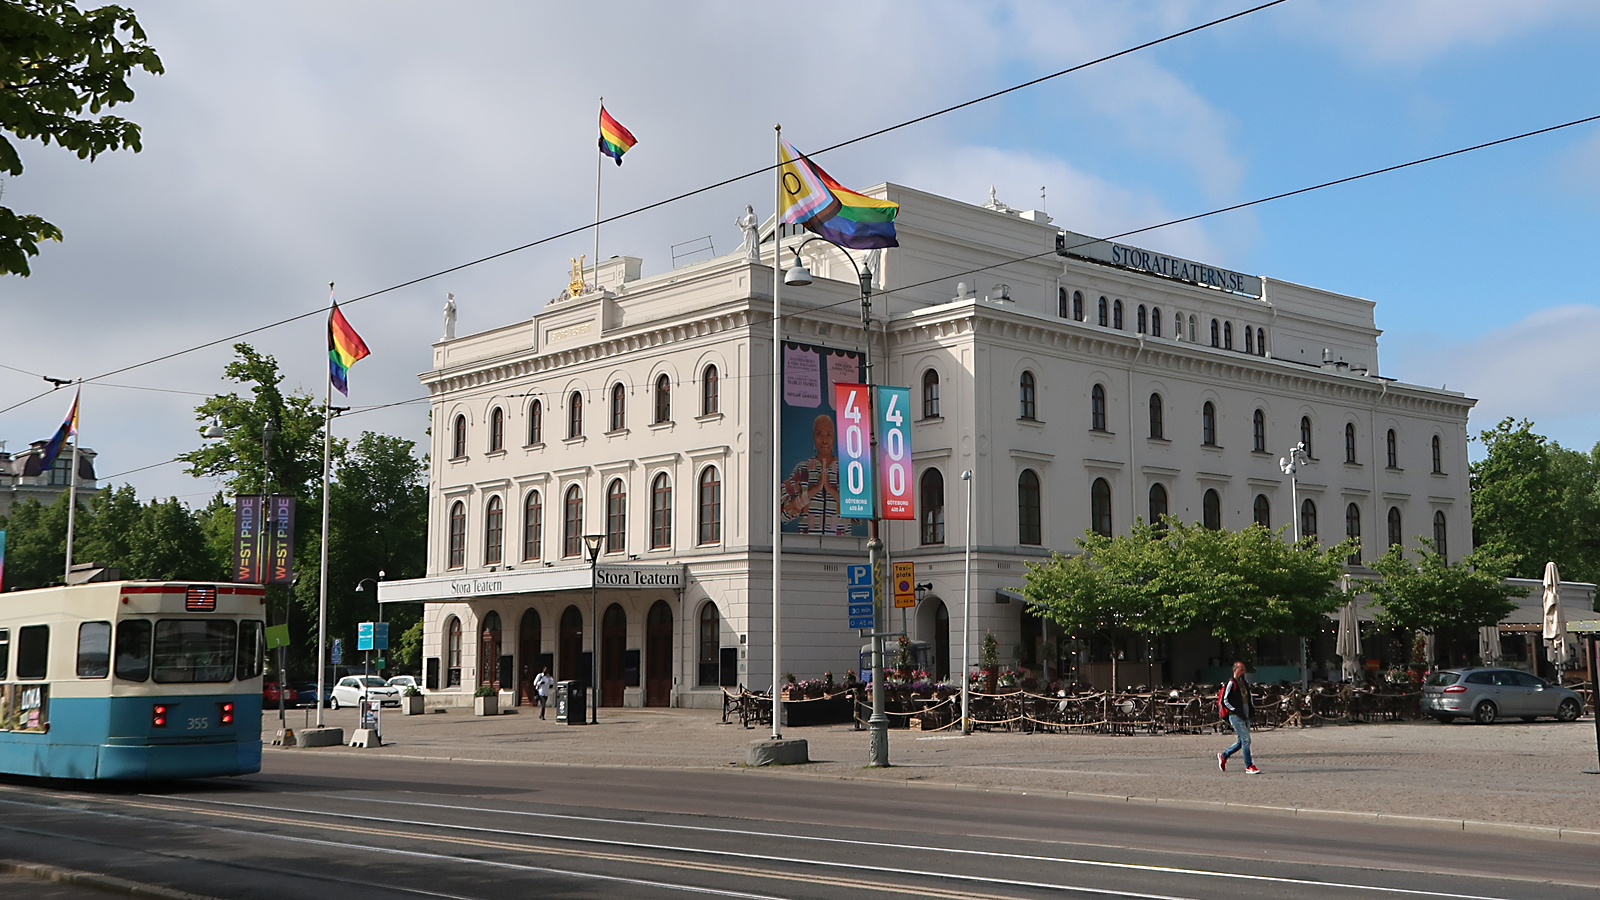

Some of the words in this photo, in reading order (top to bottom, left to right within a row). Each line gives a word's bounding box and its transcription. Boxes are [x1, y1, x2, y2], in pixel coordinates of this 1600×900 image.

[1112, 244, 1245, 291] STORATEATERN.SE
[241, 499, 253, 538] PRIDE
[278, 499, 289, 538] PRIDE
[597, 569, 630, 584] Stora
[633, 570, 679, 585] Teatern
[854, 566, 866, 584] P
[451, 581, 471, 594] Stora
[472, 579, 502, 593] Teatern
[186, 717, 208, 730] 355
